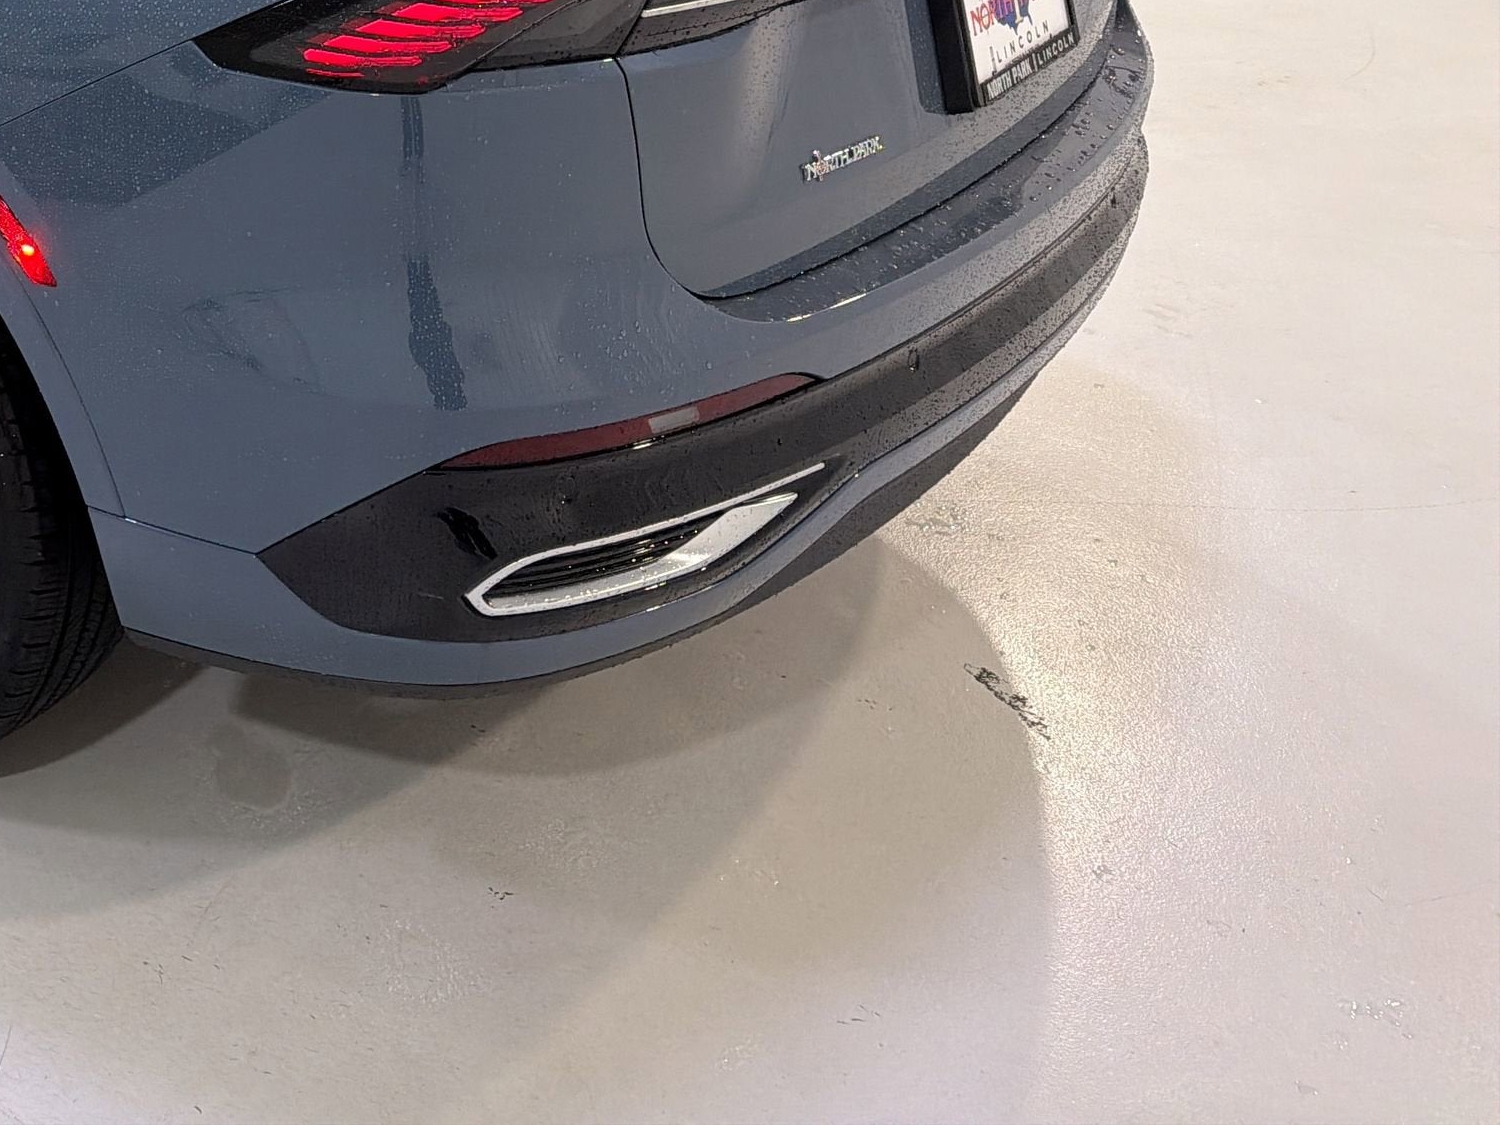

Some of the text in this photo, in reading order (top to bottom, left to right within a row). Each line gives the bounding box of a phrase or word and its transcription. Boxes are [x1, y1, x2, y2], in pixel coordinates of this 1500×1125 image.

[996, 20, 1049, 63] LINCOLN
[986, 32, 1074, 100] NORTH PARK LINCOLN
[804, 148, 849, 181] NORTH
